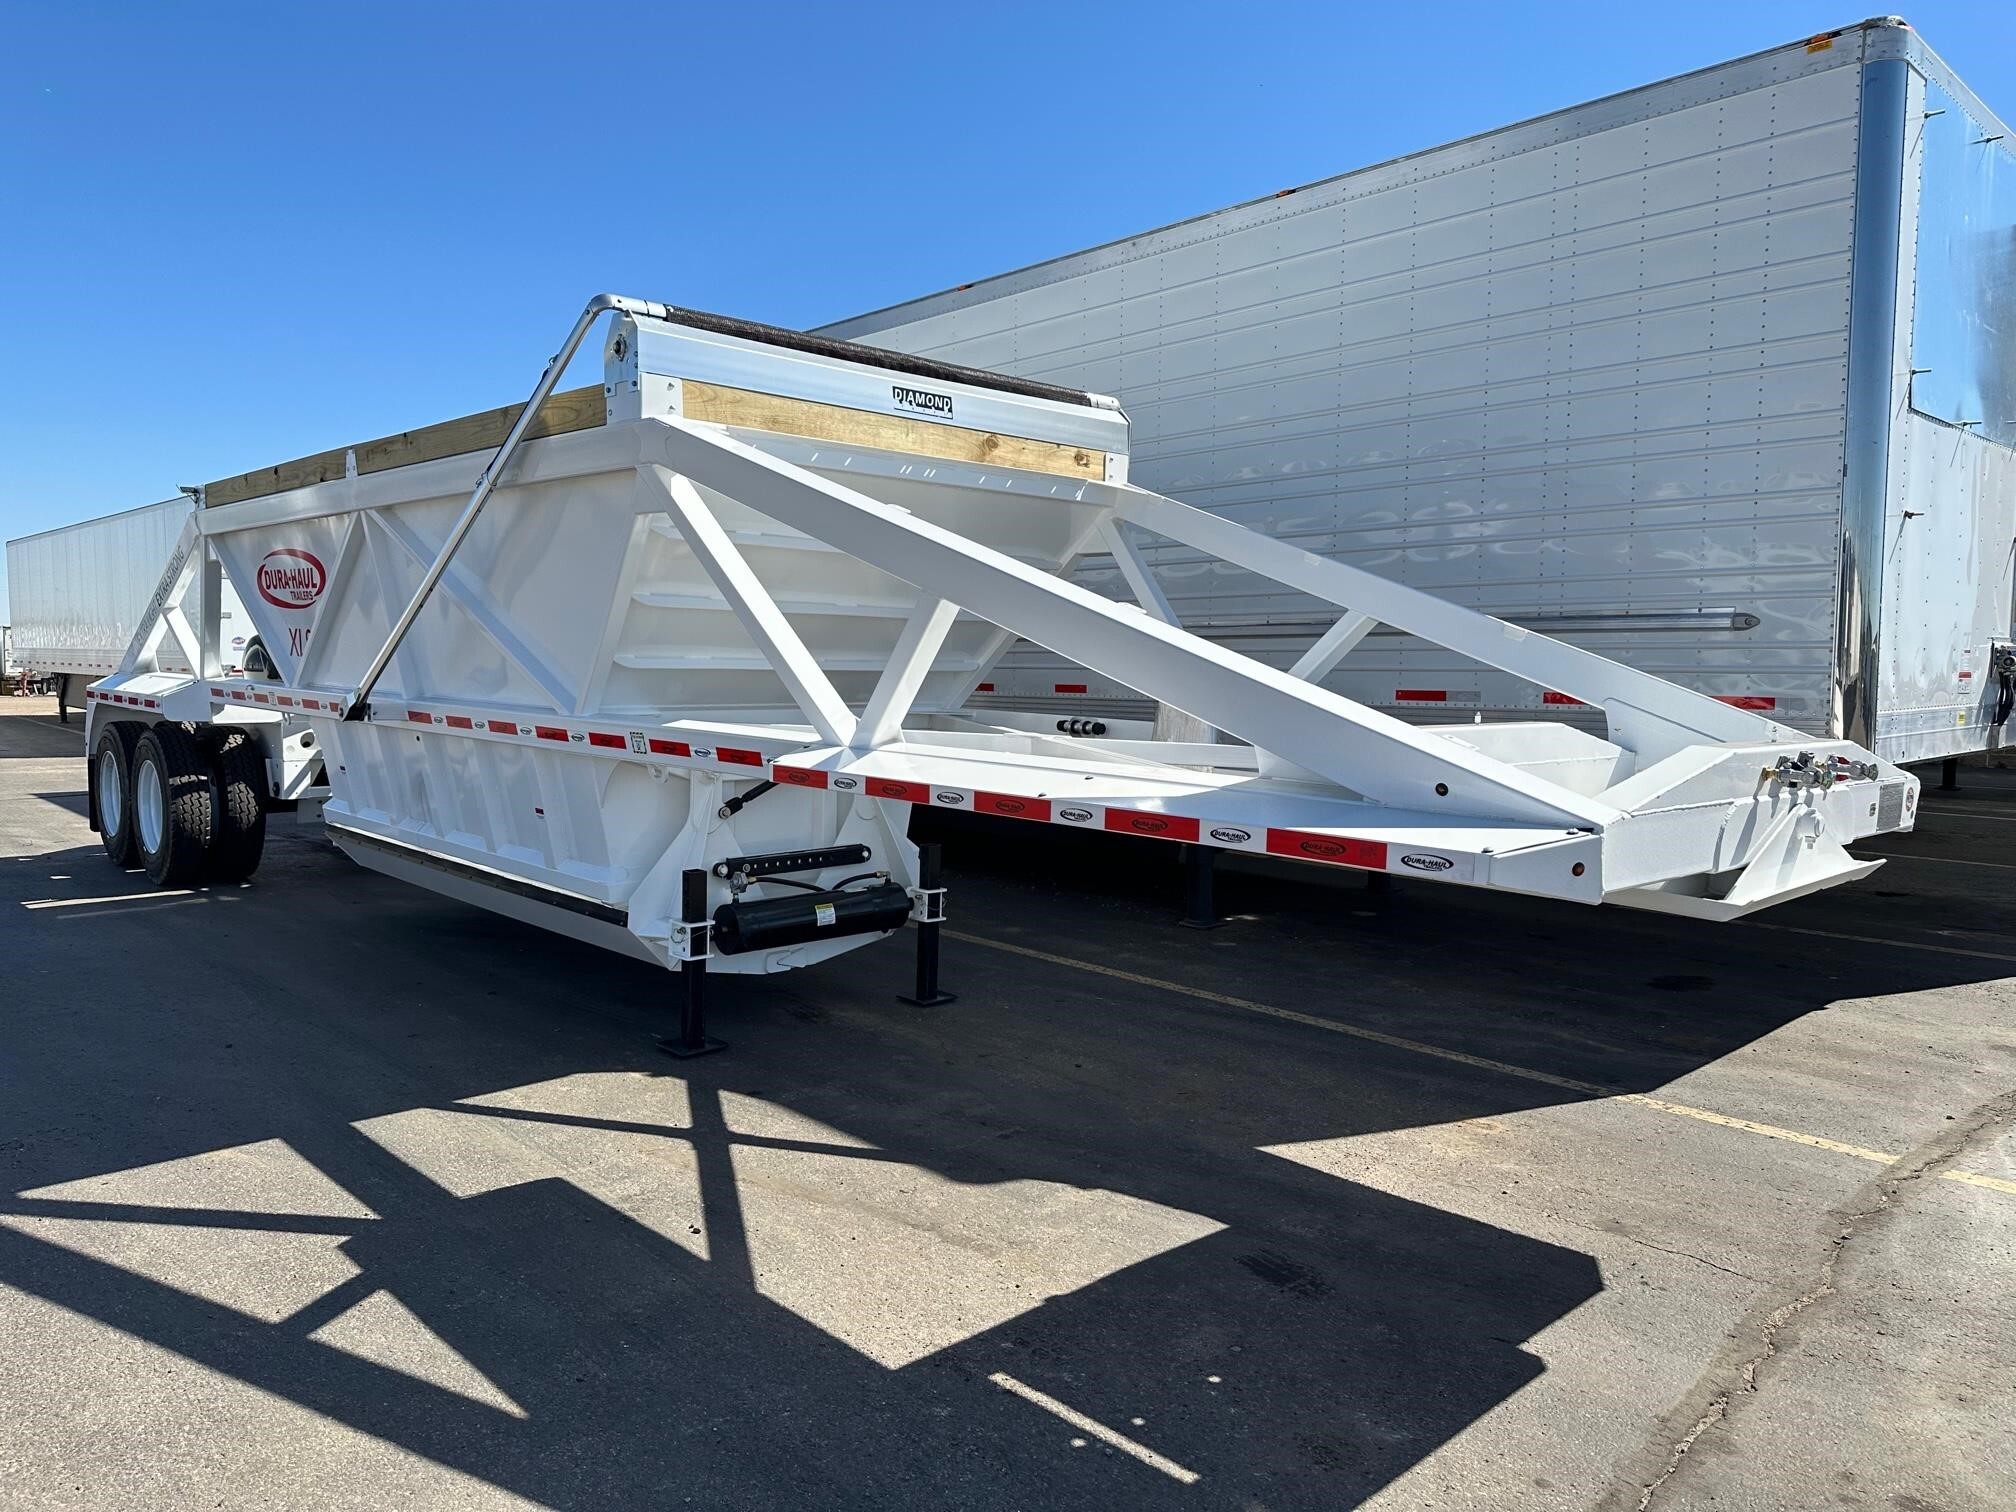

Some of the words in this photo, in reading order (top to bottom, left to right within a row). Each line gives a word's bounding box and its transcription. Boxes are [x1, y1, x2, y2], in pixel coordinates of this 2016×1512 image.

[894, 388, 951, 410] DIAMOND
[263, 567, 318, 590] DURA-HAUL
[289, 590, 314, 601] TRAILERS
[1406, 856, 1448, 869] DURA-HAUL
